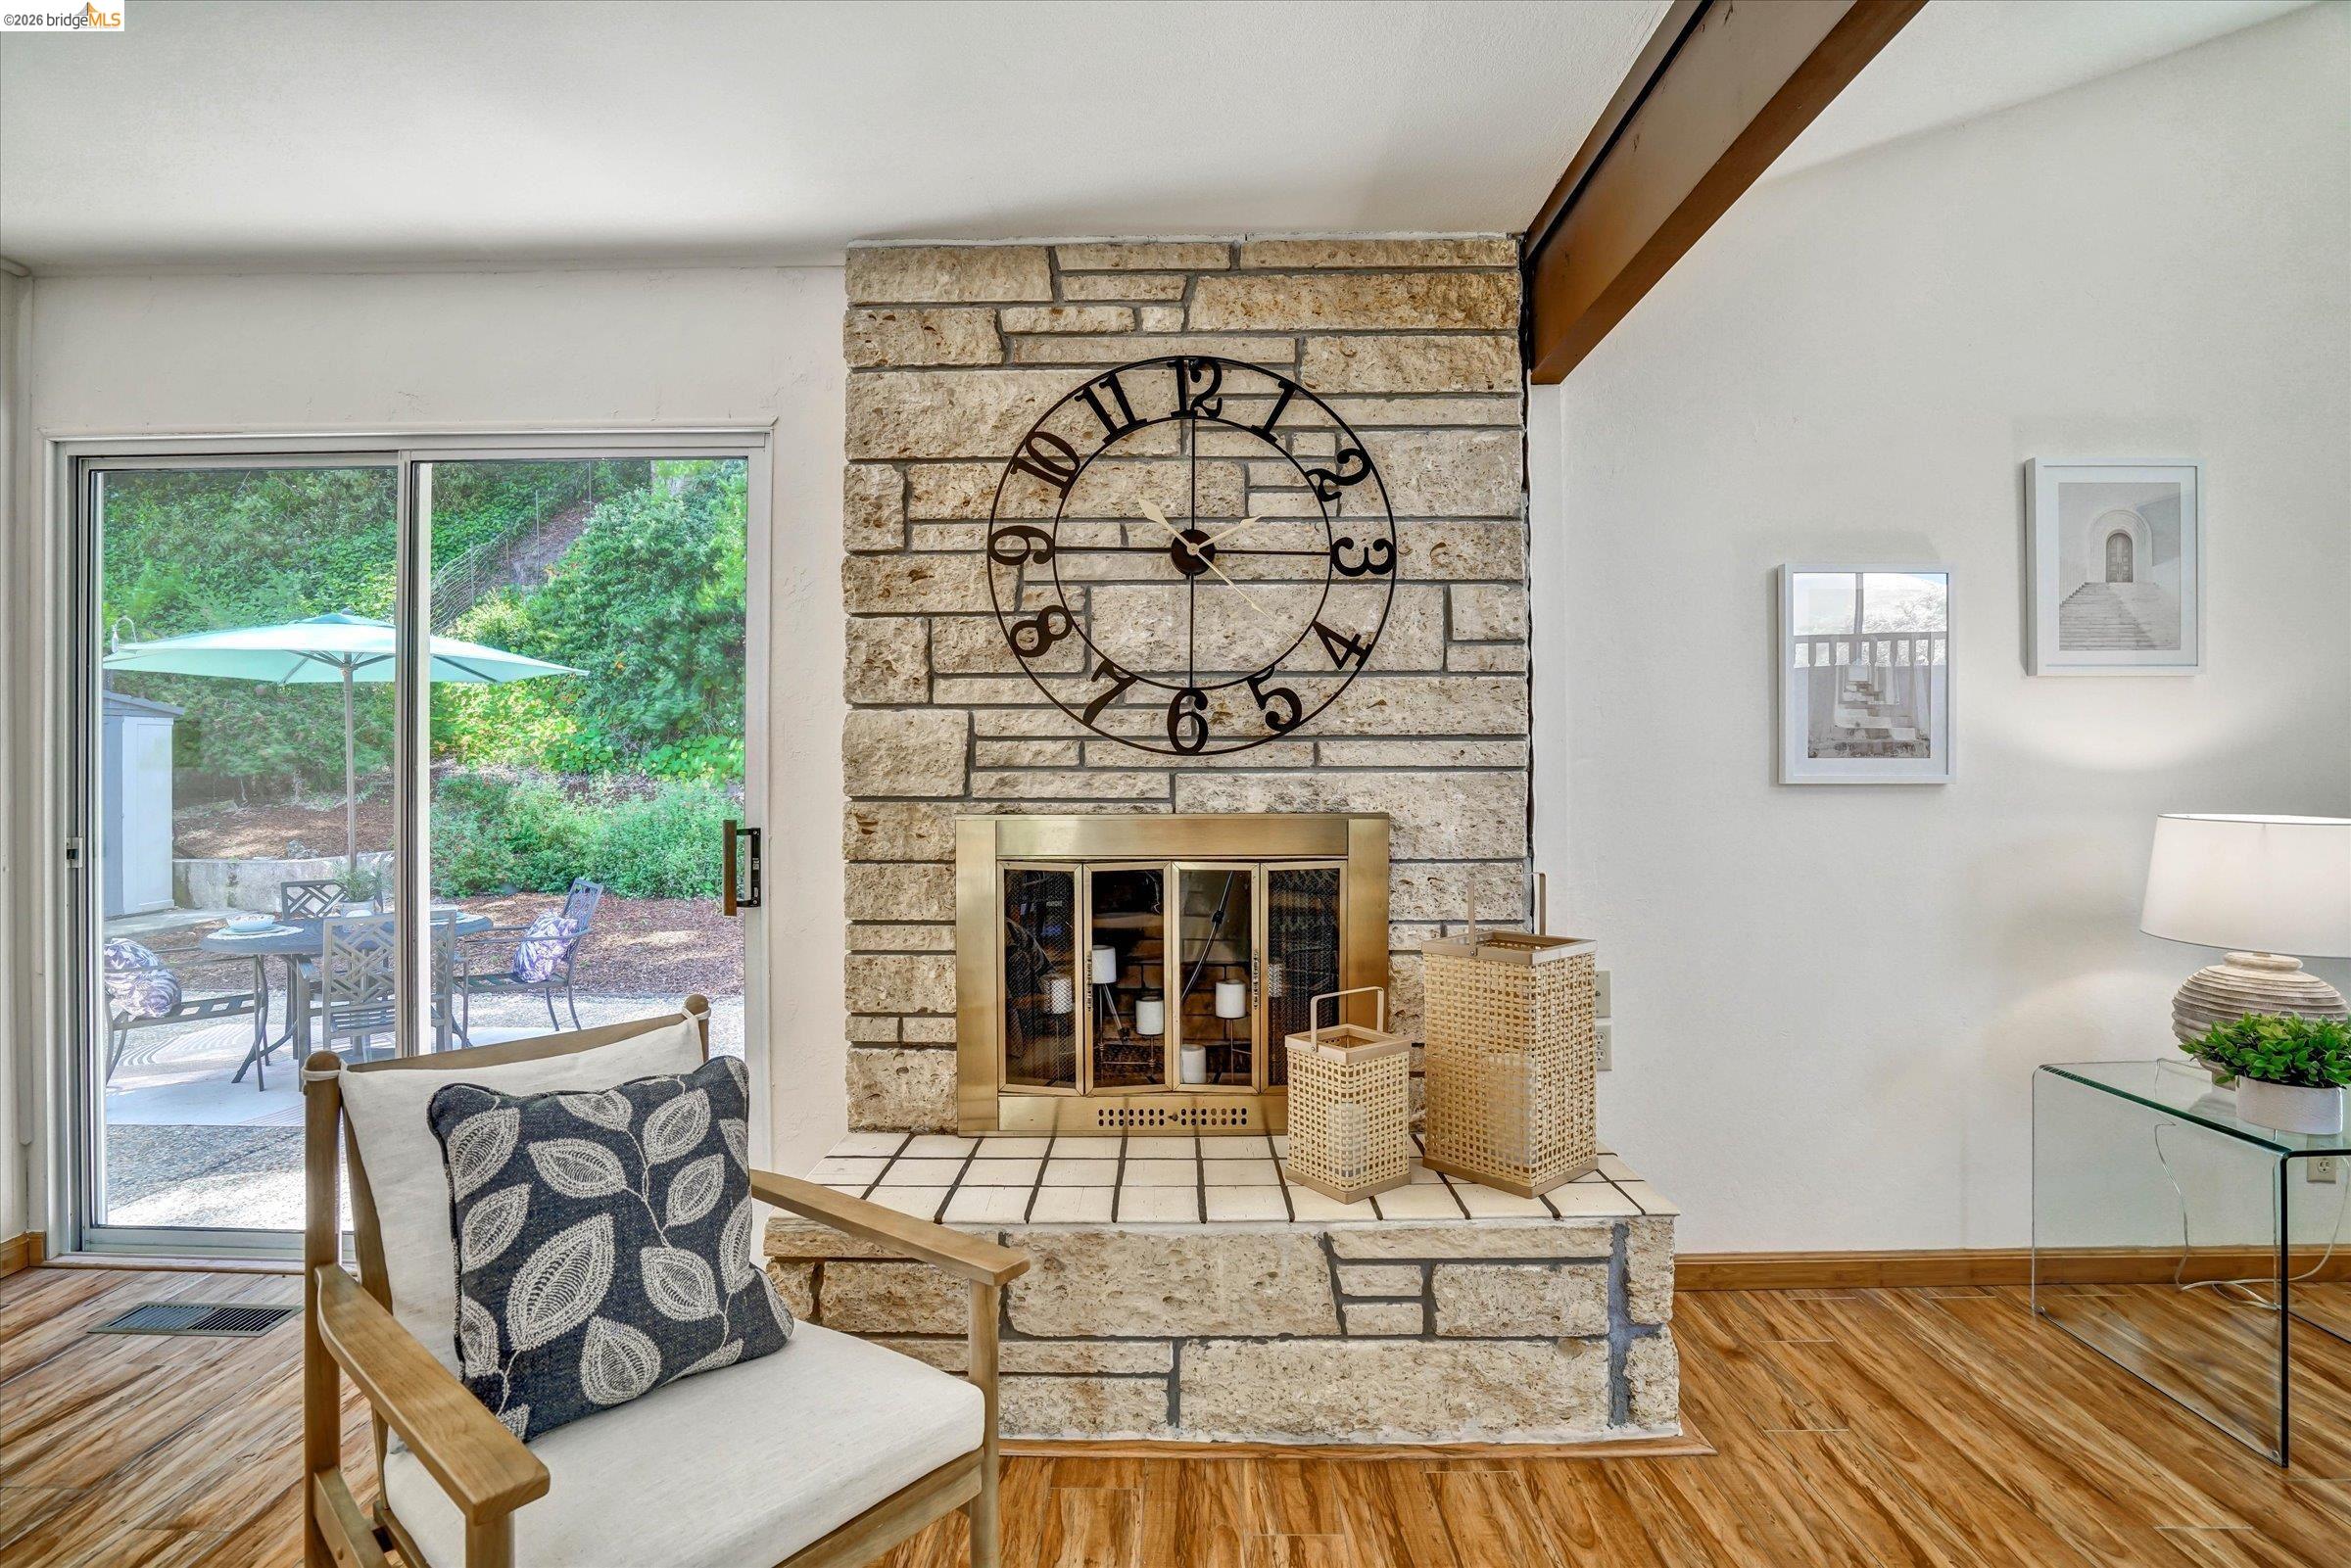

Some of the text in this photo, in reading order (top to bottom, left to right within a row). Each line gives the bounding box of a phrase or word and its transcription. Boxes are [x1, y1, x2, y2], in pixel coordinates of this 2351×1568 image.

[1075, 373, 1148, 446] 11
[1169, 358, 1223, 418] 12
[1251, 380, 1298, 444] 1
[1010, 431, 1080, 499] 10
[1306, 448, 1373, 502] 2
[989, 525, 1055, 566] 9
[1330, 537, 1396, 577] 3
[1010, 605, 1073, 657] 8
[1313, 620, 1371, 670] 4
[1082, 659, 1138, 726] 7
[1167, 689, 1209, 754] 6
[1247, 666, 1303, 733] 5
